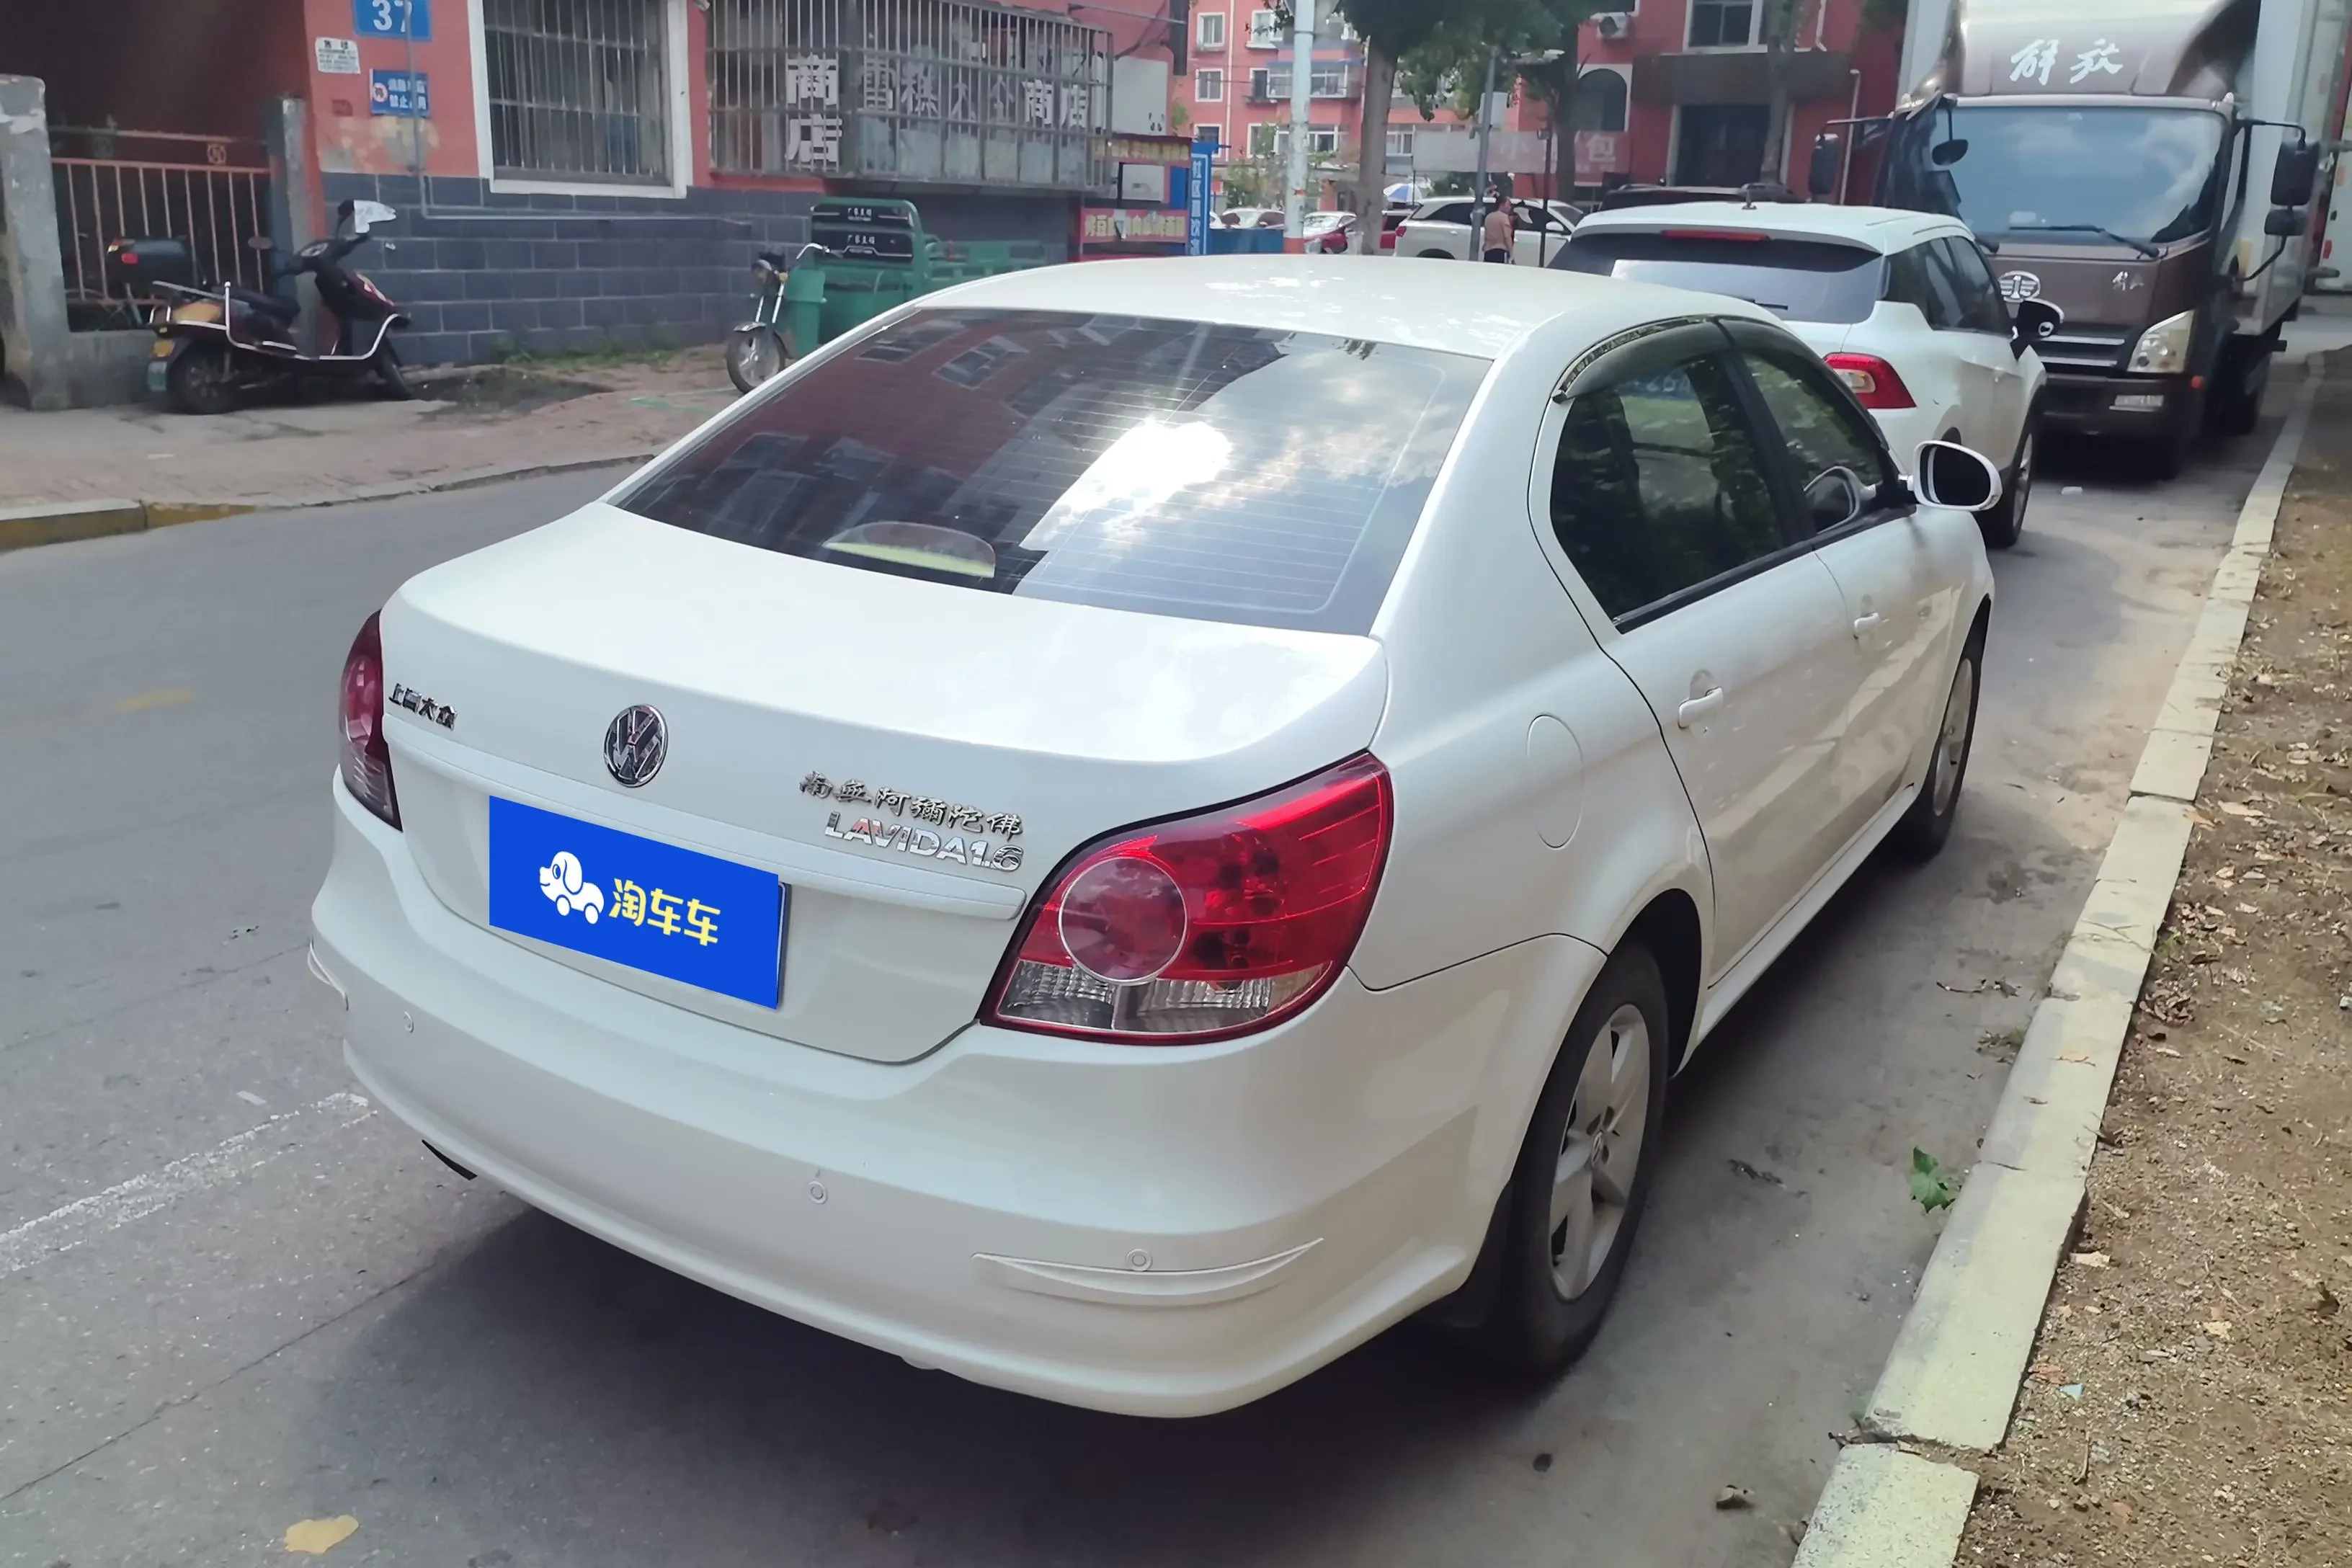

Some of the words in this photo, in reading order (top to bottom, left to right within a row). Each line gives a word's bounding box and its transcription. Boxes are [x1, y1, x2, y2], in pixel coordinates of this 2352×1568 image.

[372, 0, 412, 32] 37
[2009, 38, 2124, 86] 解放
[785, 55, 842, 172] 商店
